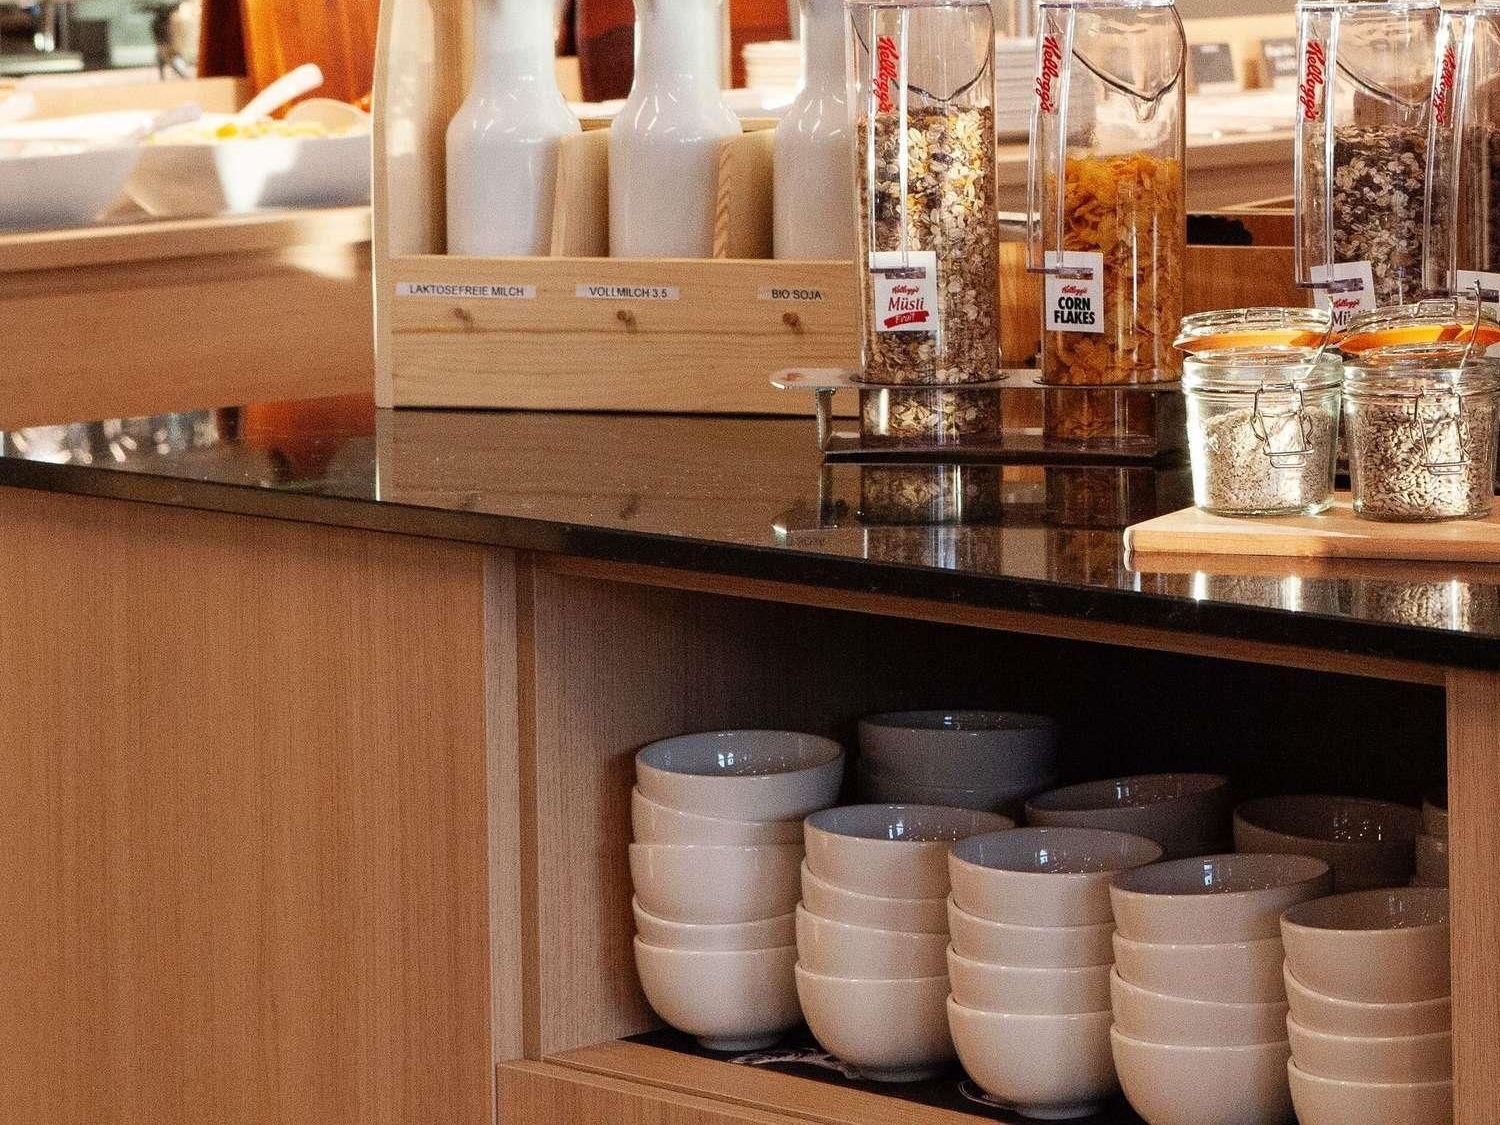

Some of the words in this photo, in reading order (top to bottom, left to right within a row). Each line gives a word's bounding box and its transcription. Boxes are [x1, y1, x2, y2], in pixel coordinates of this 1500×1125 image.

[873, 36, 899, 113] Kellogg's
[1035, 36, 1061, 113] Kellogg's
[1299, 38, 1326, 121] Kellogg's
[1433, 46, 1456, 124] Kellogg's
[409, 284, 489, 296] LAKTOSEFREIE
[491, 285, 524, 297] MILCH
[589, 286, 649, 299] VOLLMILCH
[771, 289, 790, 300] BIO
[792, 289, 822, 300] SOJA
[888, 297, 924, 311] Müsli
[1057, 296, 1091, 311] CORN
[1053, 309, 1096, 325] FLAKES
